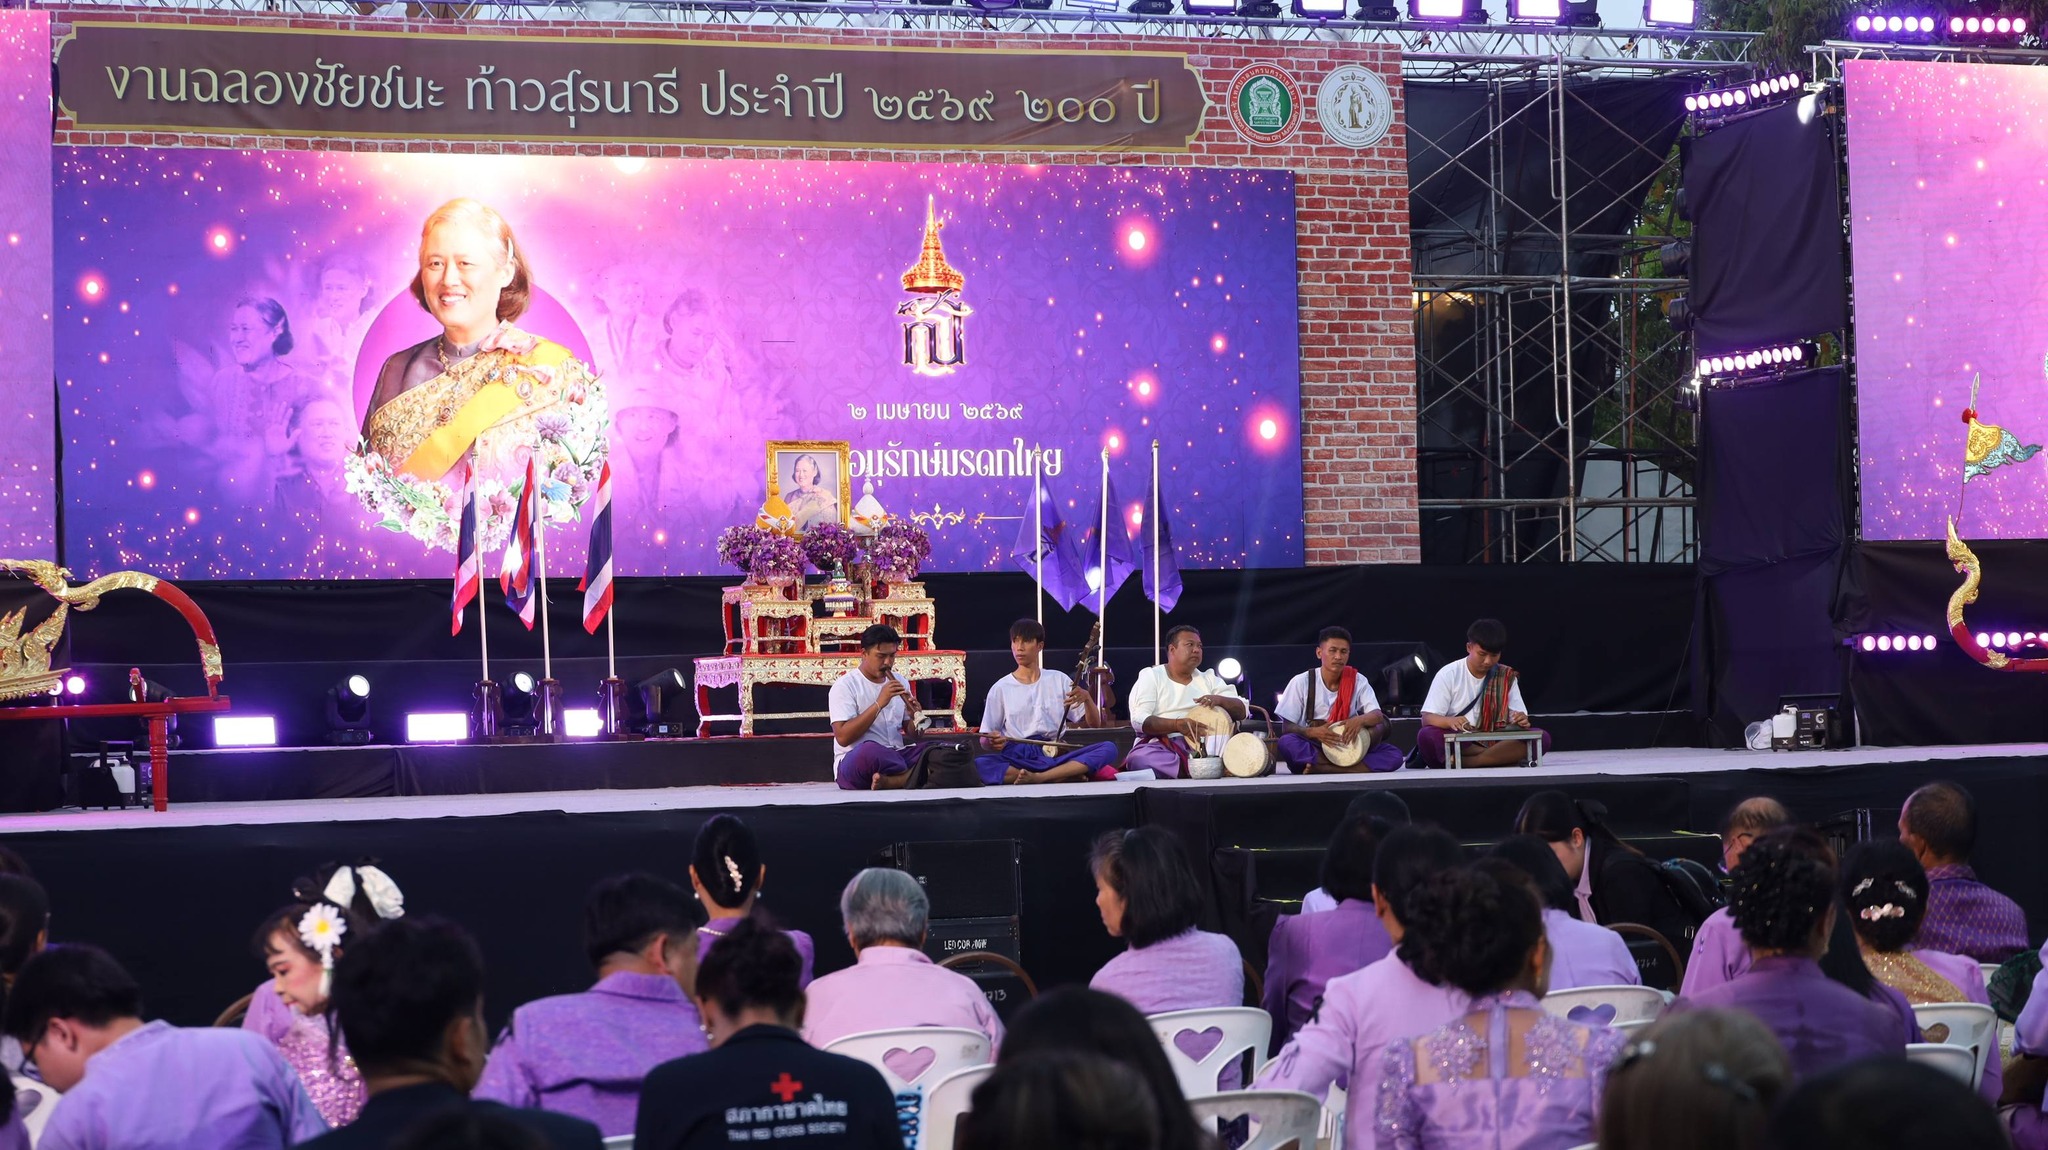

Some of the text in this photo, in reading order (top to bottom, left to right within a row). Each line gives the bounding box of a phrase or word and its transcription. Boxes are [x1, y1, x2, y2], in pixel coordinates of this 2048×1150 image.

[104, 57, 1162, 129] งานฉลองชัยชนะ ท้าวสุรนารี ประจำปี ๒๕๖๙ ๒๐๐ ปี
[847, 402, 1023, 420] ๒ เมษายน ๒๕๖๙
[752, 1127, 771, 1140] RED
[773, 1124, 805, 1139] CROSS
